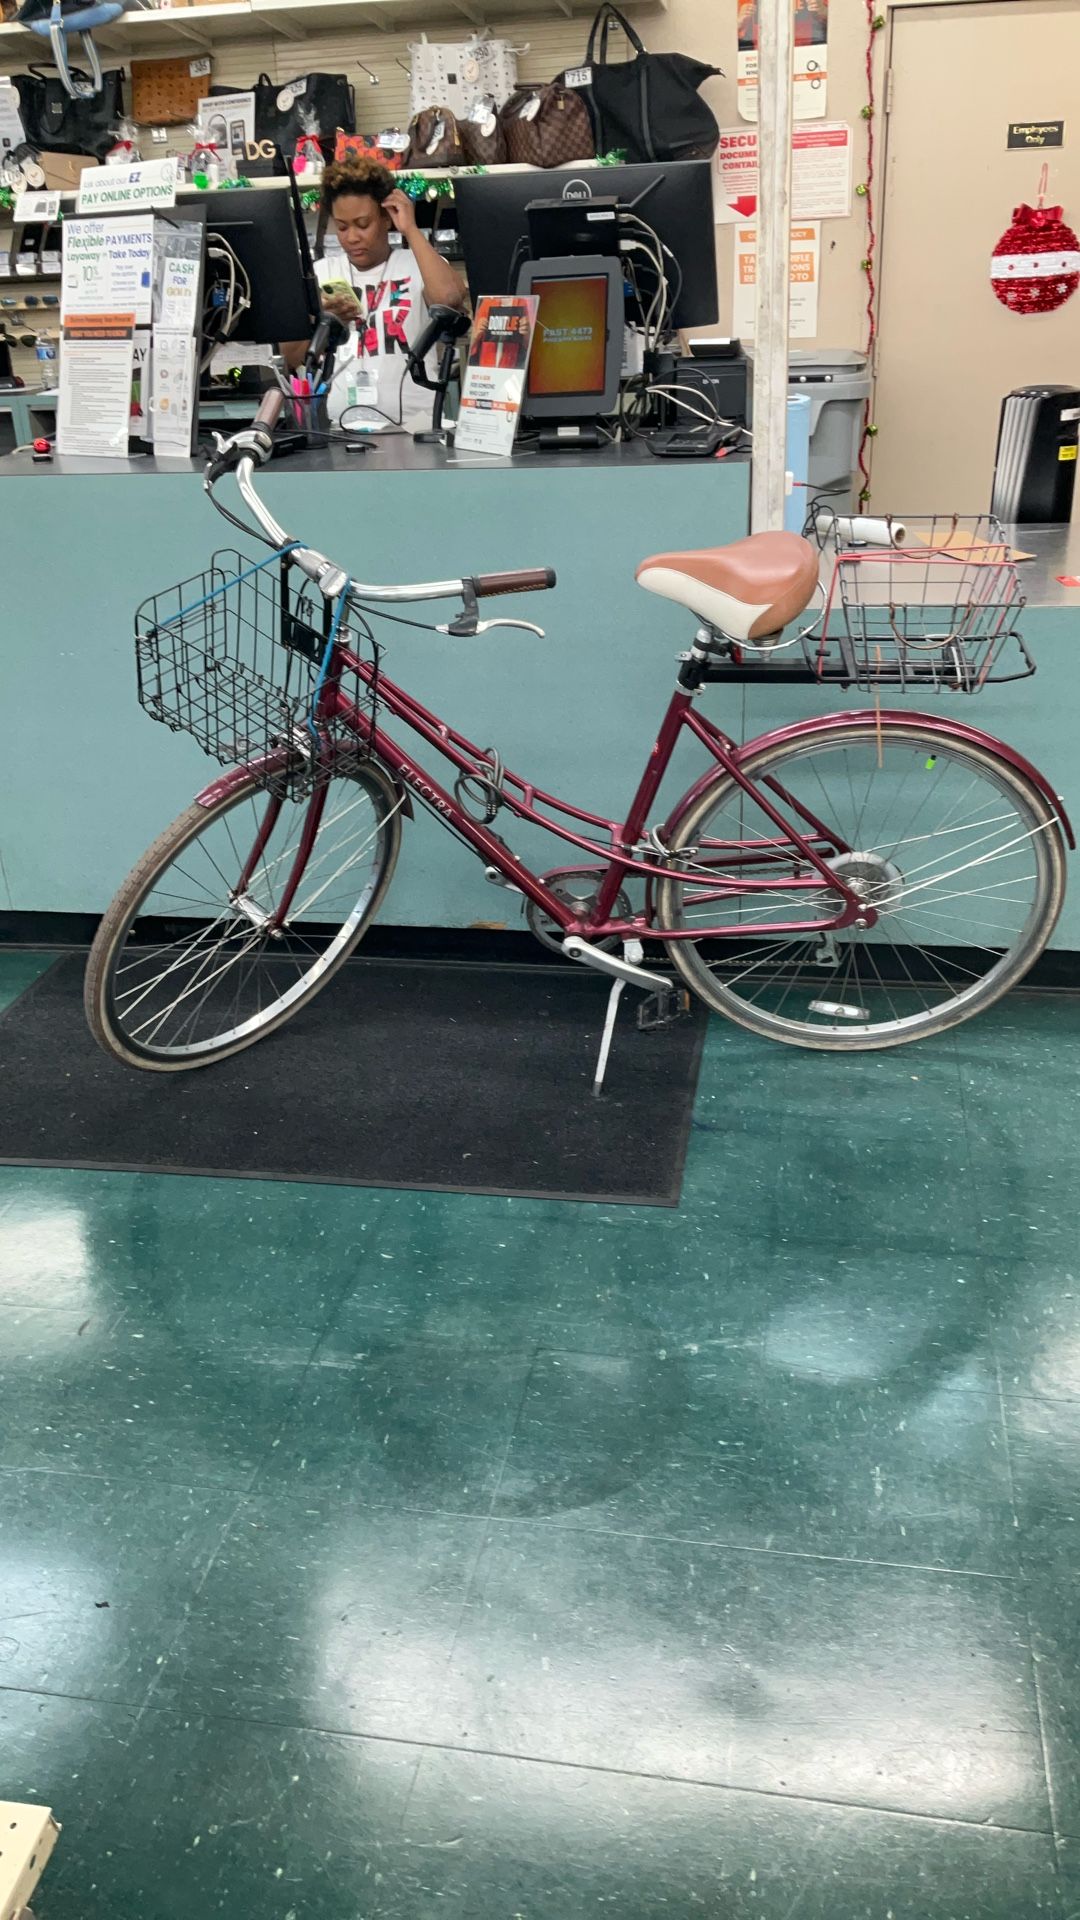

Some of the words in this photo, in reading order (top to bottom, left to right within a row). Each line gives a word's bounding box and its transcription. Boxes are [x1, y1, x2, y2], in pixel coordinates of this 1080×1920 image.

[1012, 125, 1059, 135] Employees
[720, 135, 757, 149] SECU
[1025, 135, 1045, 145] Only
[246, 138, 277, 161] DG
[719, 150, 758, 160] DOCUME
[722, 160, 758, 170] CONTAI
[129, 172, 141, 184] EZ
[81, 193, 99, 205] PAY
[100, 189, 131, 202] ONLINE
[133, 184, 173, 199] OPTIONS
[67, 223, 81, 235] We
[83, 223, 105, 234] offer
[67, 235, 104, 249] Flexible
[105, 233, 152, 246] PAYMENTS
[67, 252, 100, 264] Layaway
[108, 250, 127, 259] Take
[128, 248, 151, 260] Today
[169, 262, 195, 274] CASH
[173, 275, 187, 285] FOR
[398, 763, 453, 818] ELECTRA
